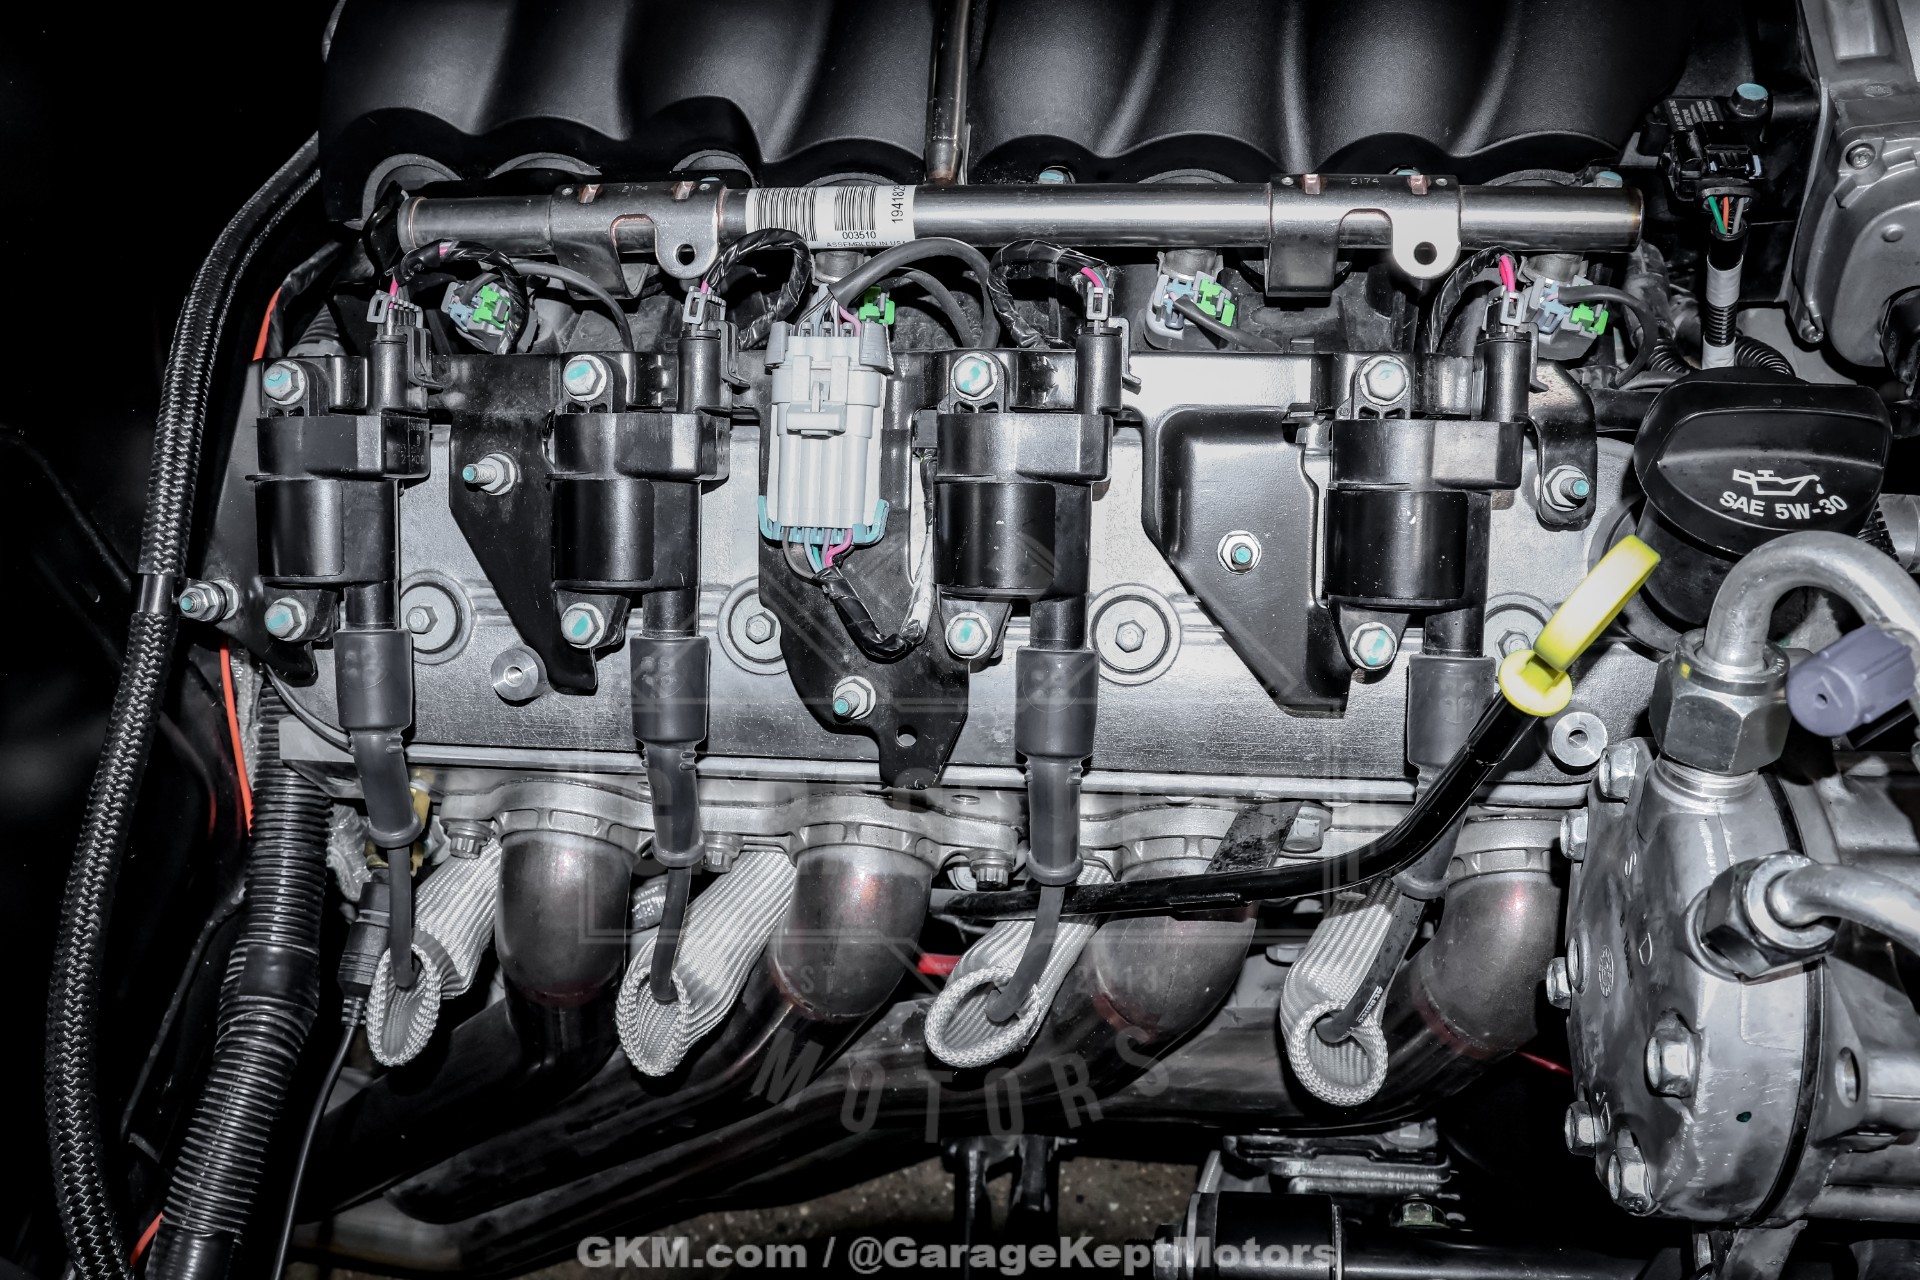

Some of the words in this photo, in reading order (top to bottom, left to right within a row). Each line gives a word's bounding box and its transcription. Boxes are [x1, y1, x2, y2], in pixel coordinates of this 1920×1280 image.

[842, 230, 877, 240] 003510
[1719, 490, 1766, 518] SAE
[1774, 494, 1849, 520] 5W-30
